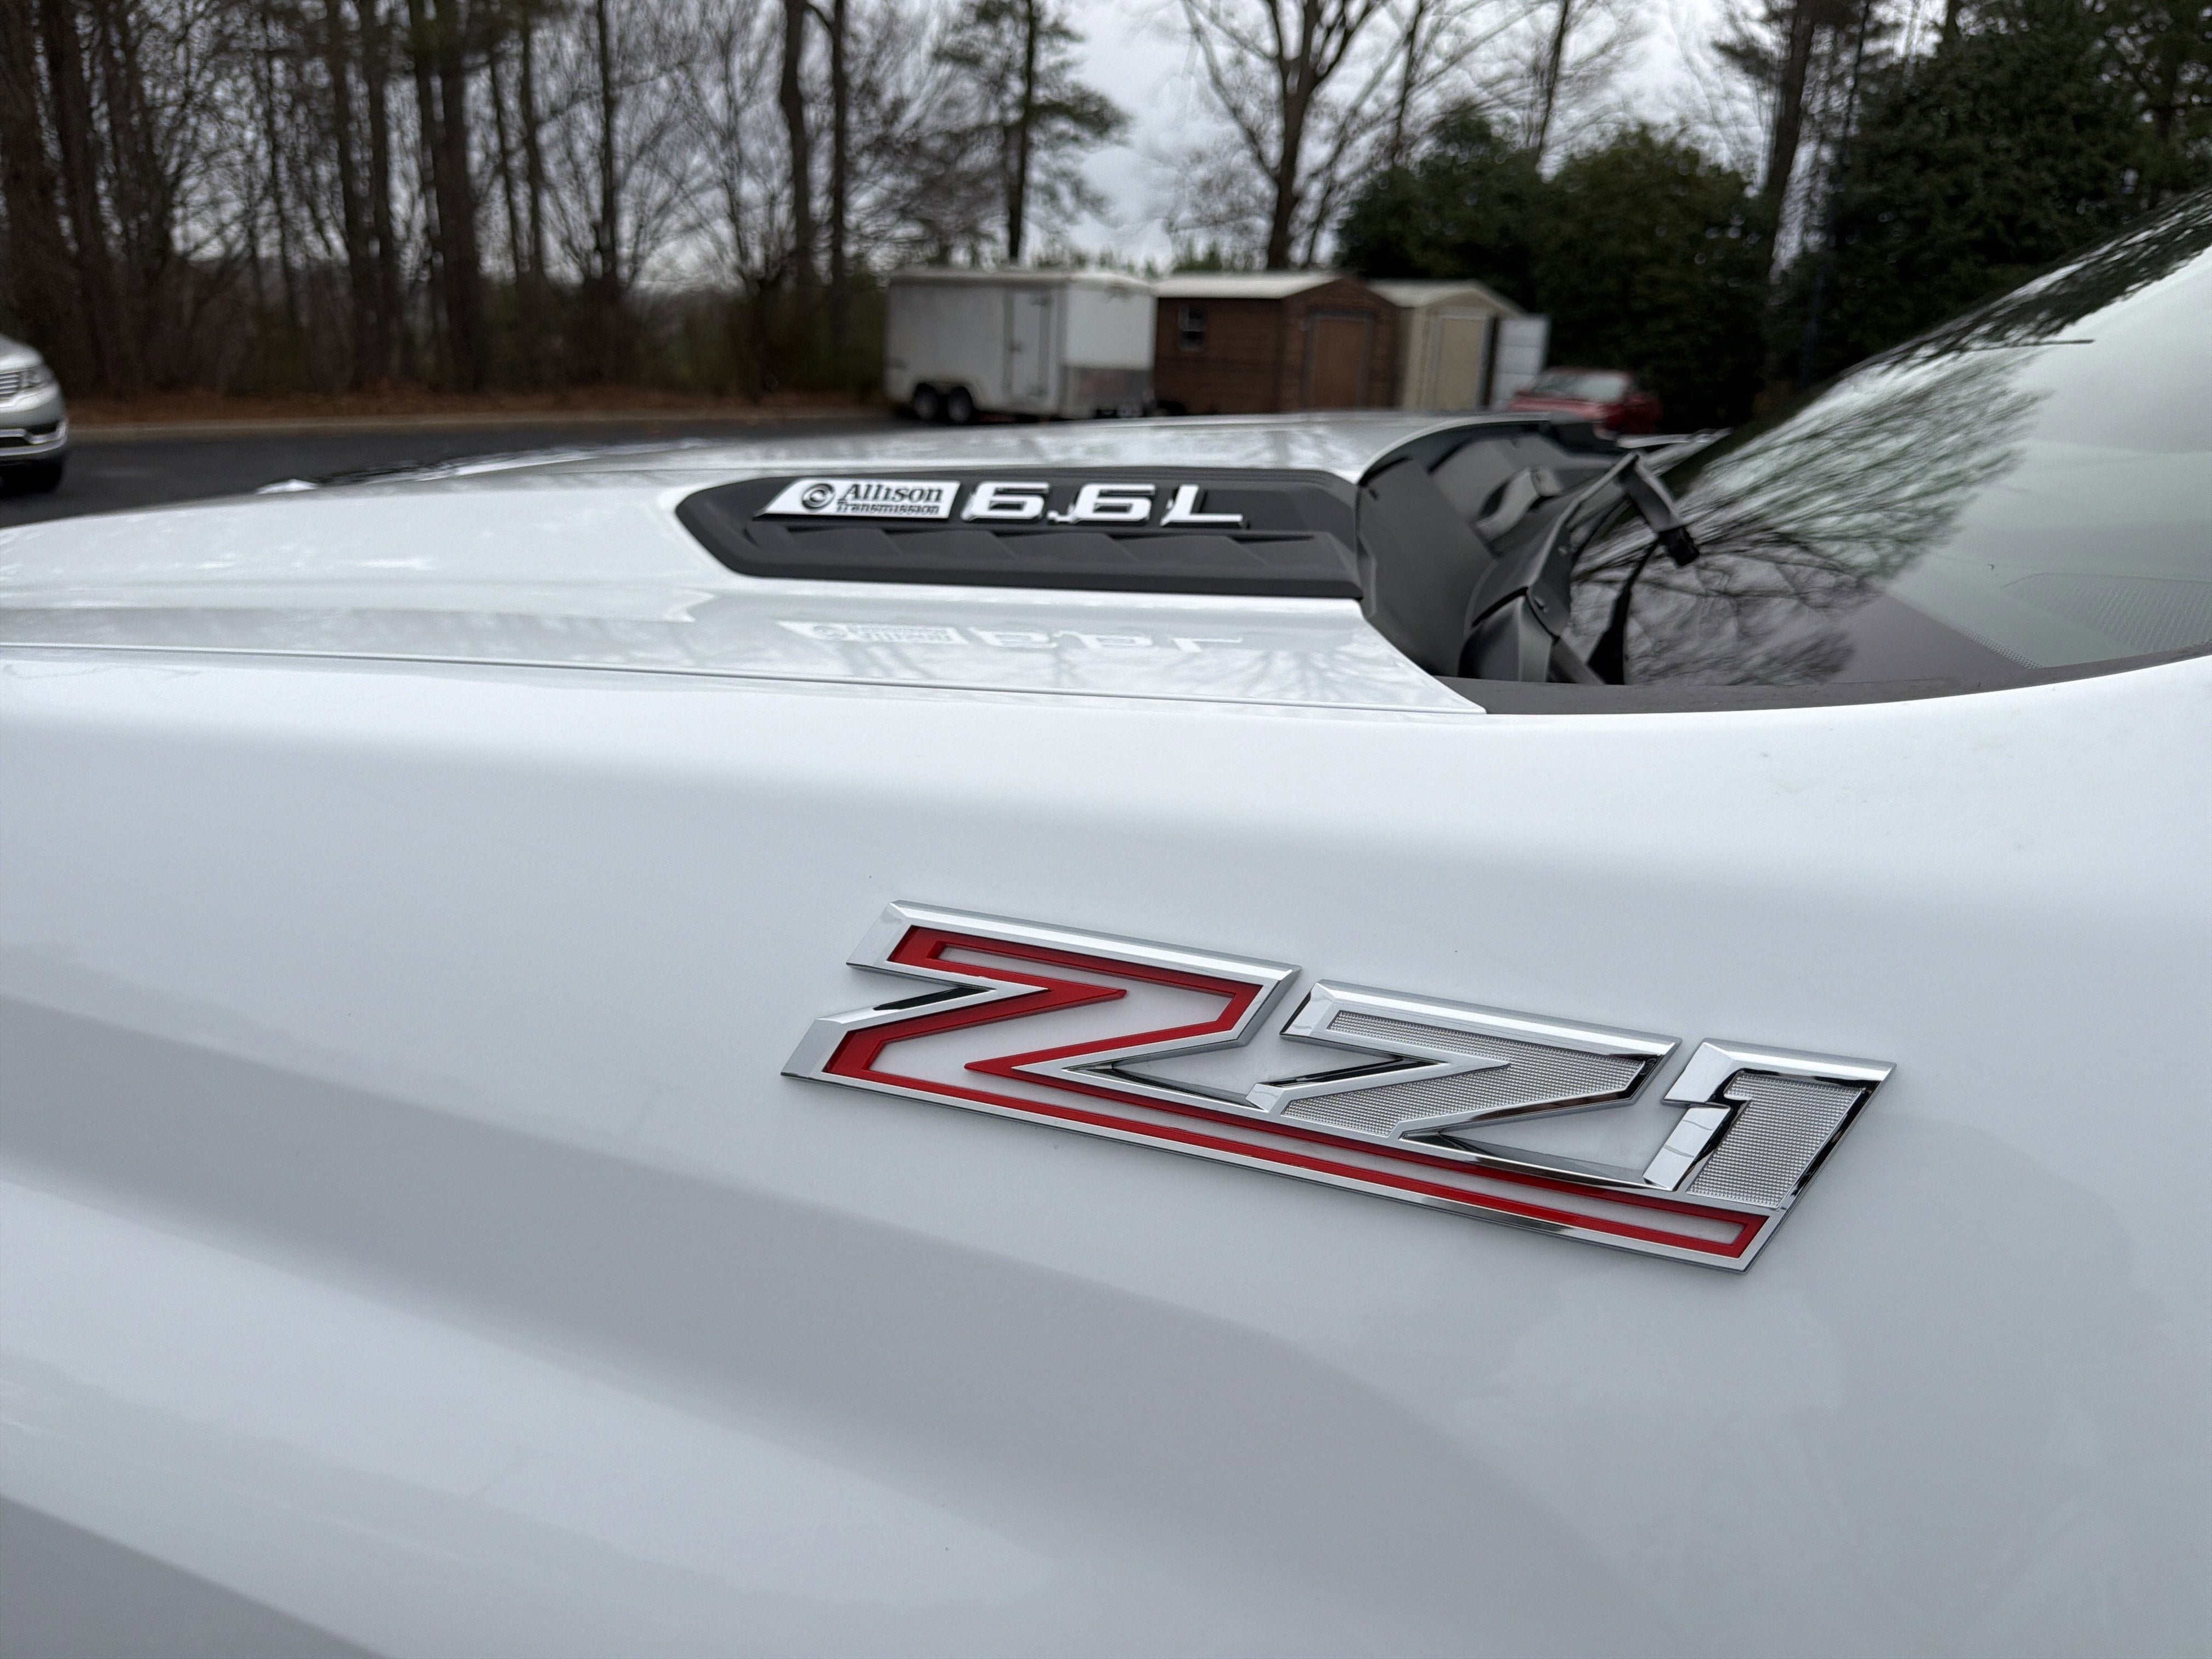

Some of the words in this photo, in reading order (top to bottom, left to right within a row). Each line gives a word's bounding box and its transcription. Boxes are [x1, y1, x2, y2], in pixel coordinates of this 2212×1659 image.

[836, 501, 940, 515] Transmission
[838, 483, 943, 503] Allison
[961, 481, 1245, 526] 6.6L
[782, 900, 1898, 1274] Z71
